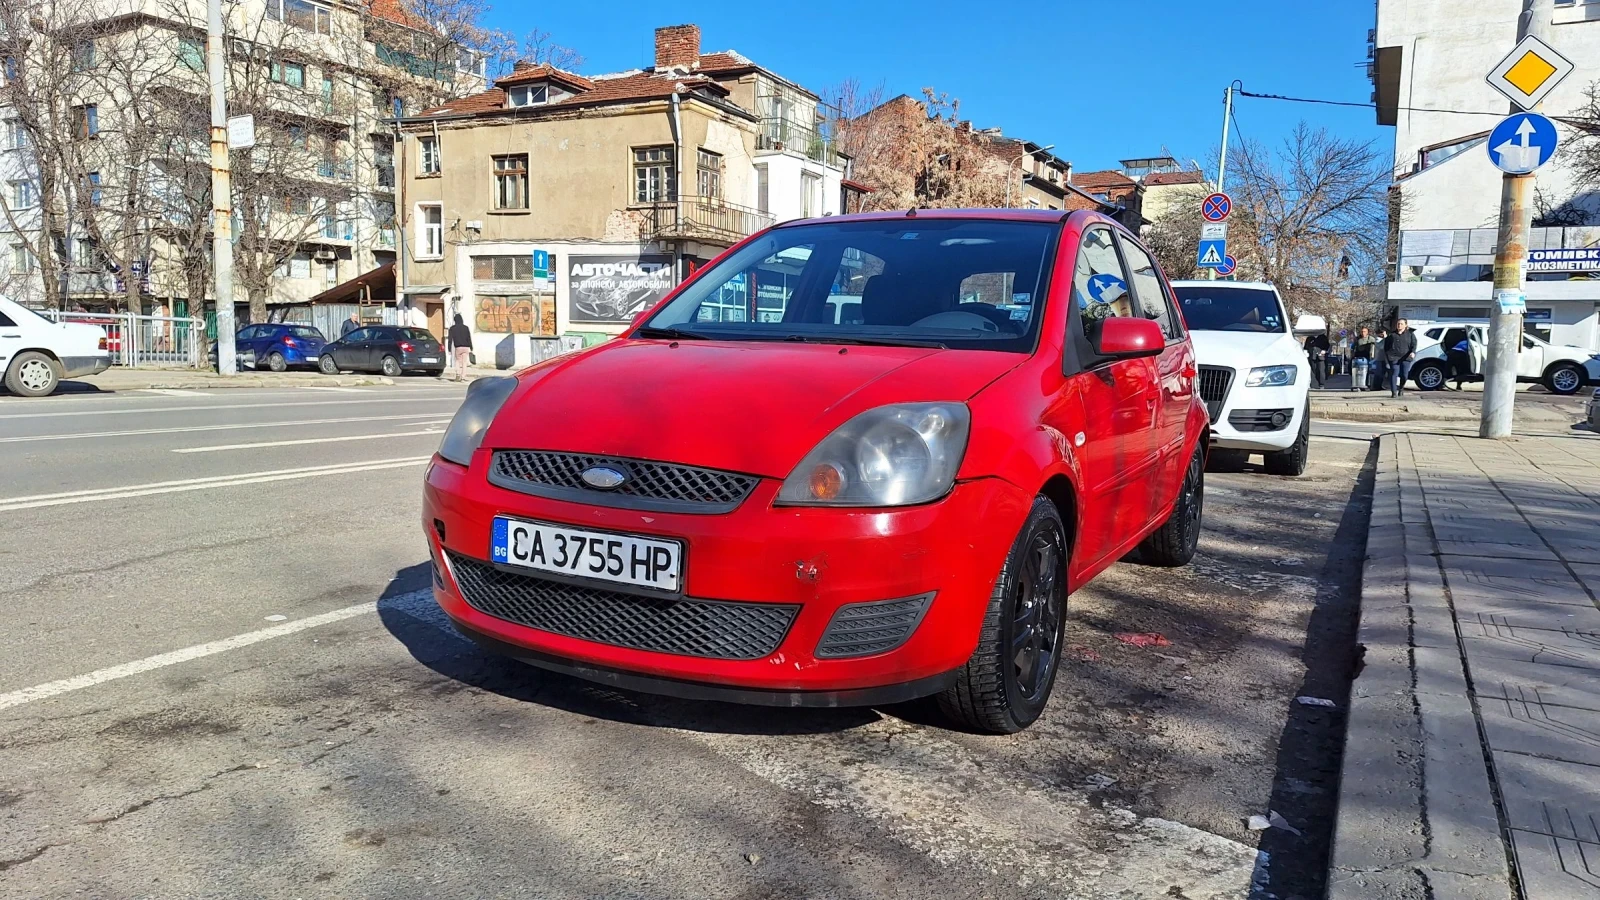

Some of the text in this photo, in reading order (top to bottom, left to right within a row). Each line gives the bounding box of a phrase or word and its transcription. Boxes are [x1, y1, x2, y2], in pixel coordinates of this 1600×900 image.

[570, 263, 671, 277] АВТОЧАСТИ
[571, 280, 671, 289] за ЯПОНСКИ АВТОМОБИЛИ
[494, 546, 507, 557] BG
[512, 527, 672, 582] CA 3755 HP
